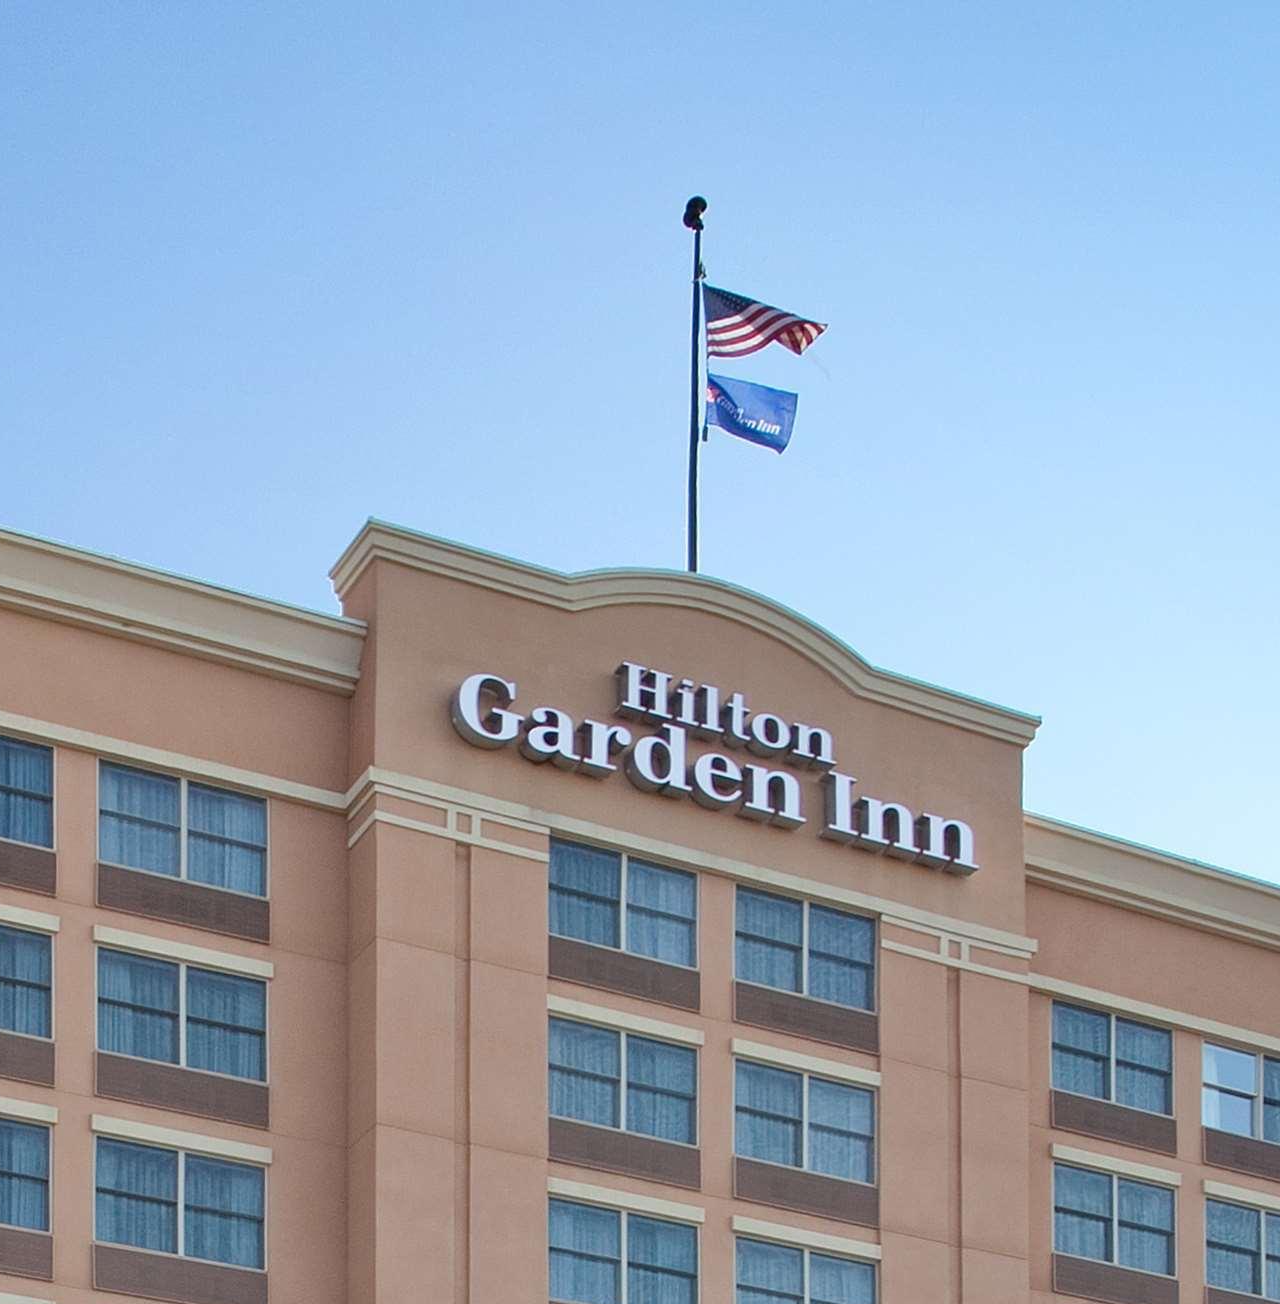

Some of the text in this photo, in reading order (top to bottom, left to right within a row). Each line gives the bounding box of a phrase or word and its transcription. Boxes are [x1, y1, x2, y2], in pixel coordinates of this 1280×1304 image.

[456, 672, 980, 873] Garden Inn
[619, 660, 838, 769] Hilton
